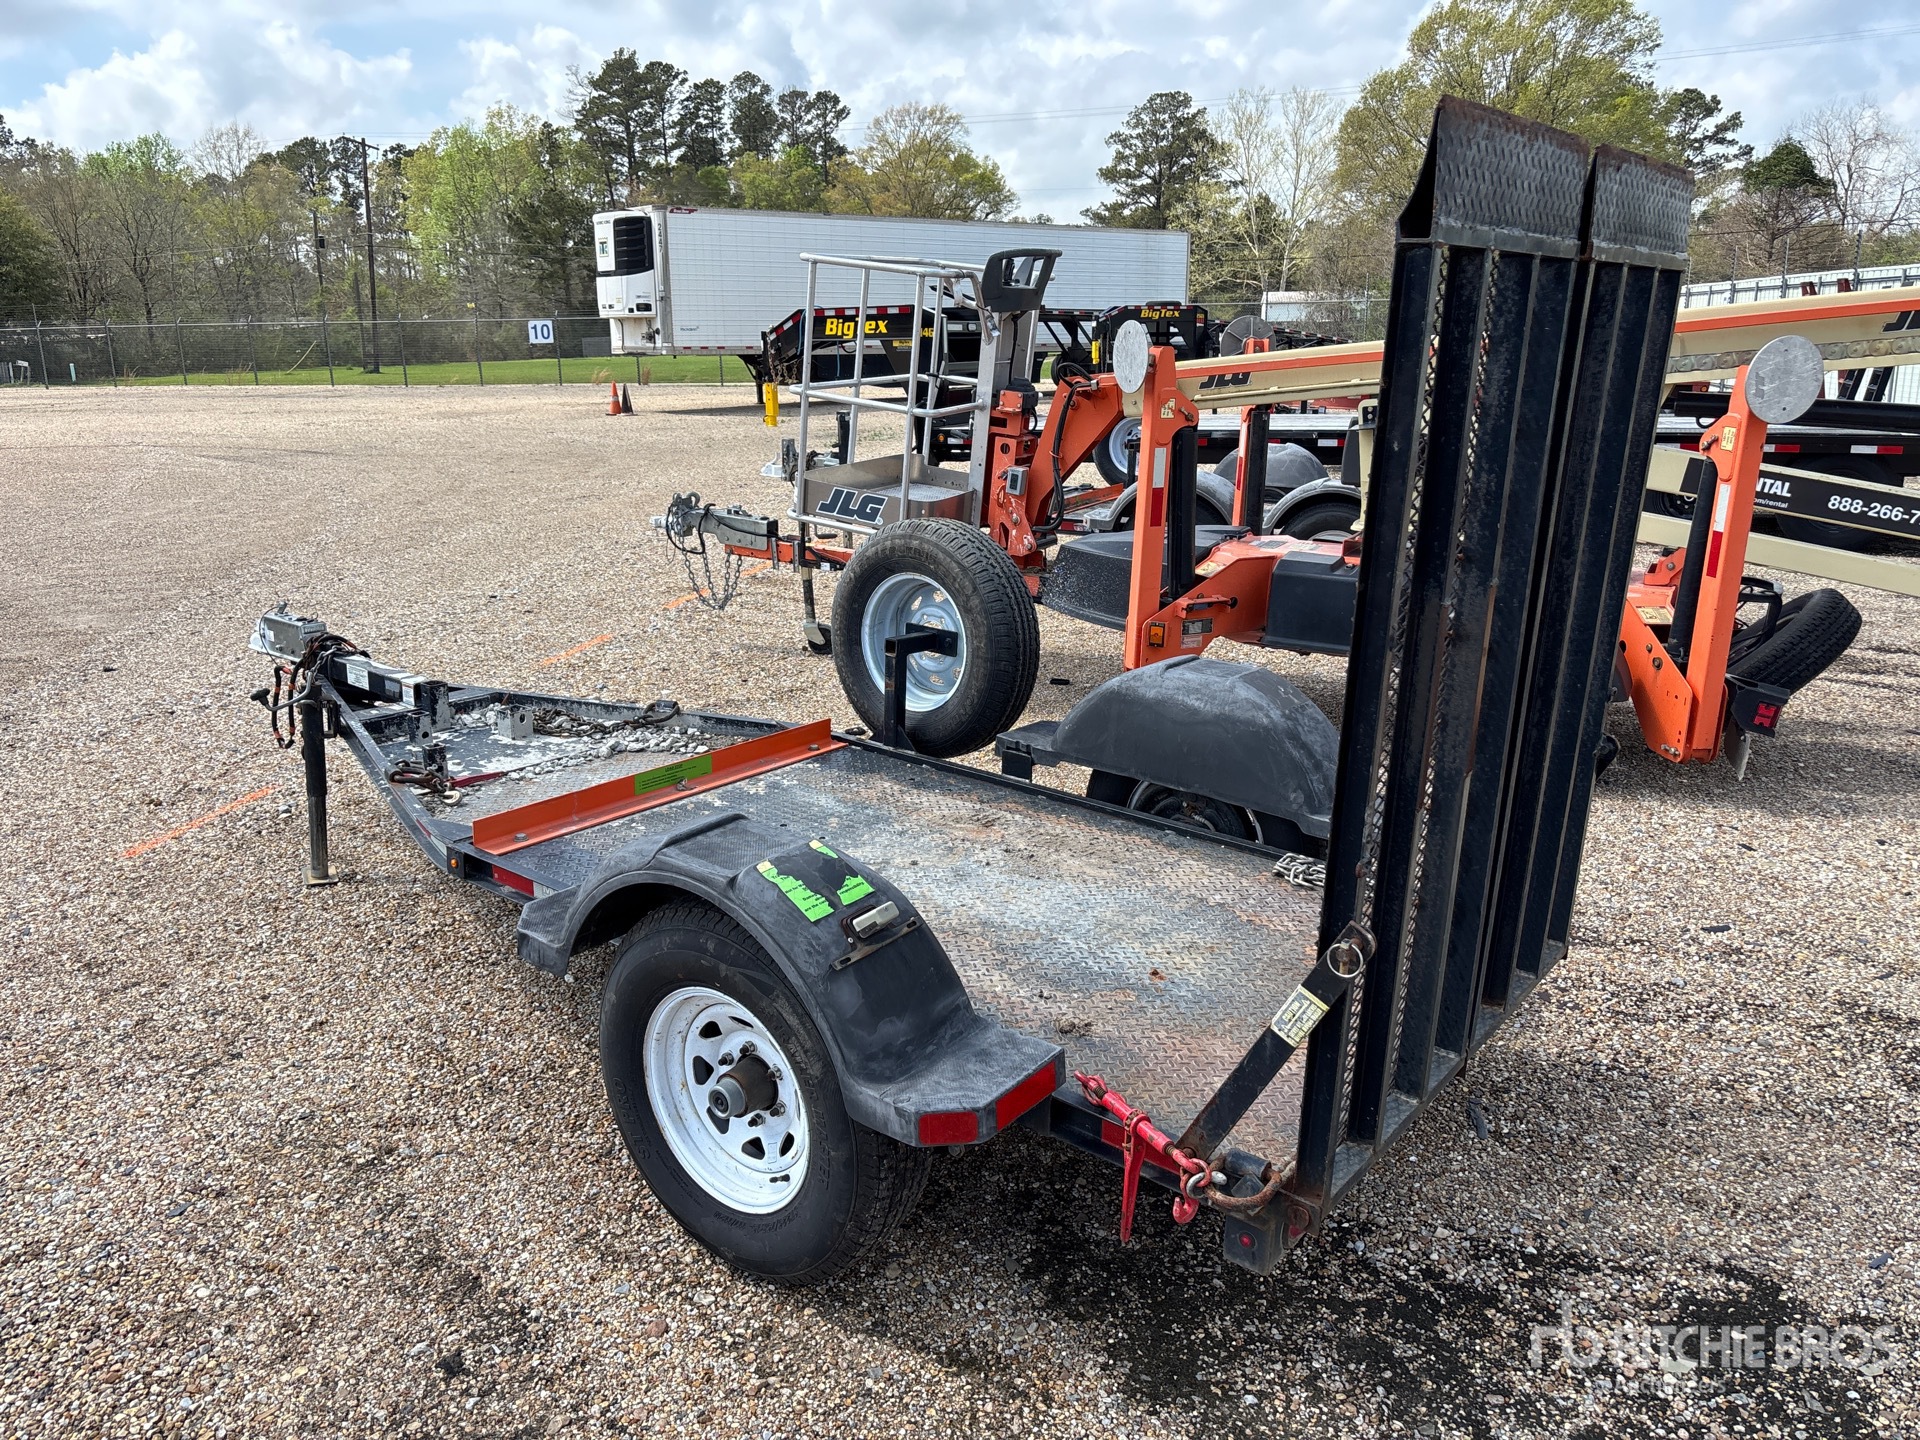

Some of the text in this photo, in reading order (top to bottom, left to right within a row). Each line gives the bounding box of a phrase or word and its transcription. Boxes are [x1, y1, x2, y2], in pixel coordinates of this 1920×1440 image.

[1141, 309, 1181, 320] BigTex
[530, 323, 551, 340] 10
[1198, 372, 1252, 390] JLG
[1755, 478, 1791, 497] NTAL
[815, 486, 889, 524] JLG
[1753, 497, 1789, 509] om/rental
[1828, 495, 1920, 524] 888-266-7
